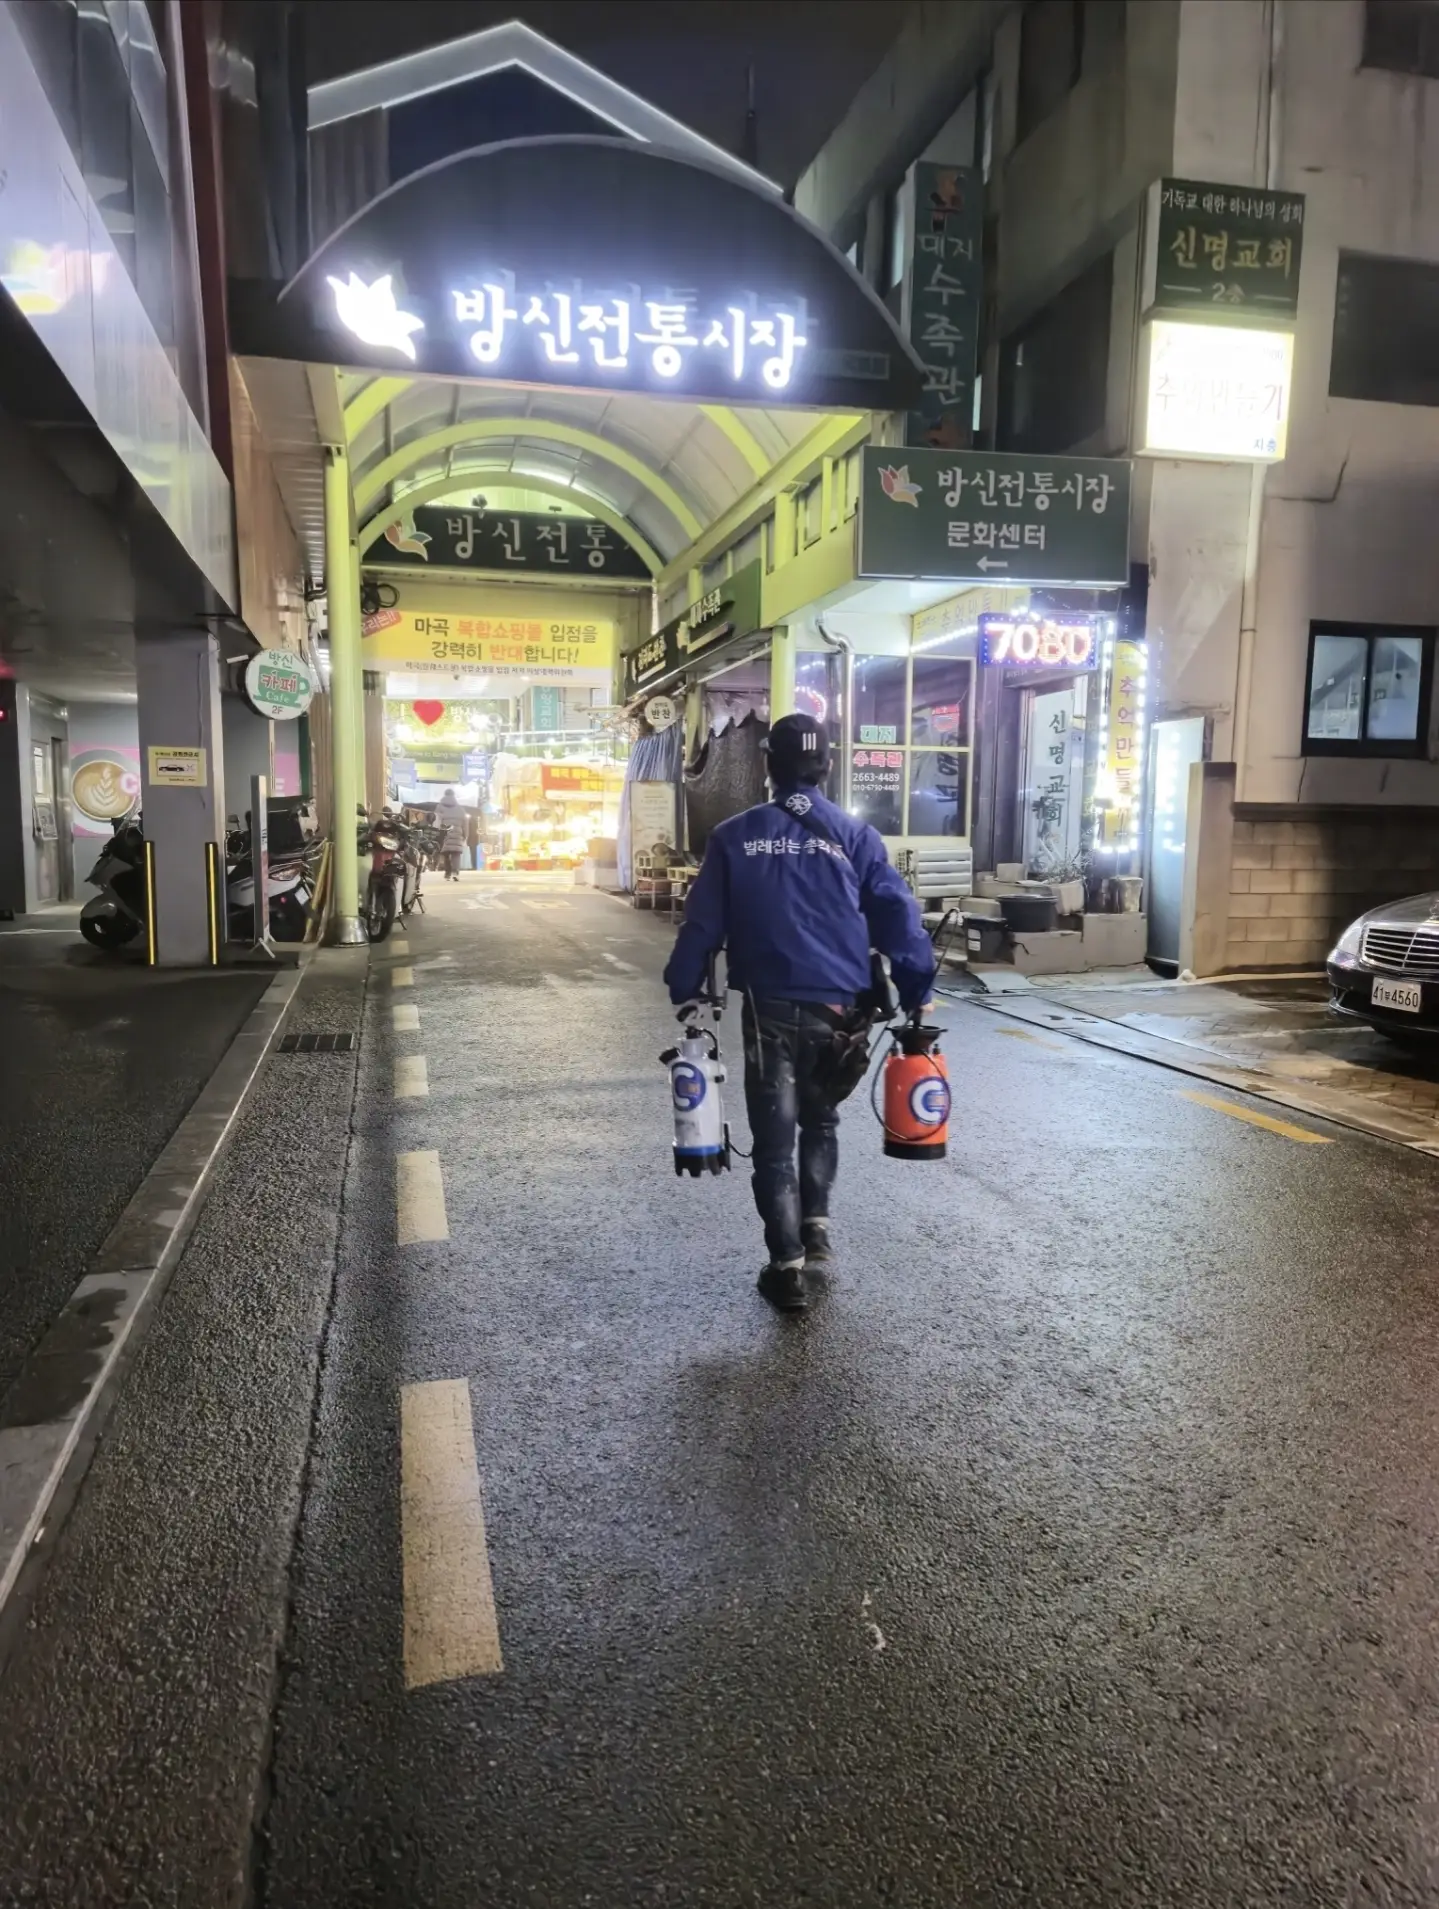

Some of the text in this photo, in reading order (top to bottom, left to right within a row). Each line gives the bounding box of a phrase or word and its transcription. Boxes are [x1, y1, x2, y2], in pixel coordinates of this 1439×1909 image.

[1162, 188, 1198, 211] 기독교
[1202, 192, 1226, 214] 대한
[1229, 195, 1276, 220] 하나님의
[1169, 225, 1293, 280] 신명교회
[1211, 282, 1246, 304] 2층
[450, 282, 809, 390] 방신전통시장
[920, 262, 967, 407] 수족관
[937, 465, 1116, 515] 방신전통시장
[445, 513, 633, 569] 방신전통
[946, 520, 1047, 551] 문화센터
[414, 617, 599, 644] 마곡 복합쇼핑몰 입점을
[430, 640, 580, 664] 강력히 반대합니다!
[984, 621, 1092, 666] 7080
[268, 651, 294, 670] 방신
[262, 669, 298, 693] 카페
[266, 690, 289, 704] Cafe
[271, 705, 284, 715] 2F
[650, 707, 672, 720] 반찬
[859, 724, 898, 744] 대지
[853, 750, 904, 768] 수족관
[1048, 709, 1067, 827] 신명교회
[852, 772, 901, 782] 2663-4489
[743, 836, 802, 857] 벌레잡는
